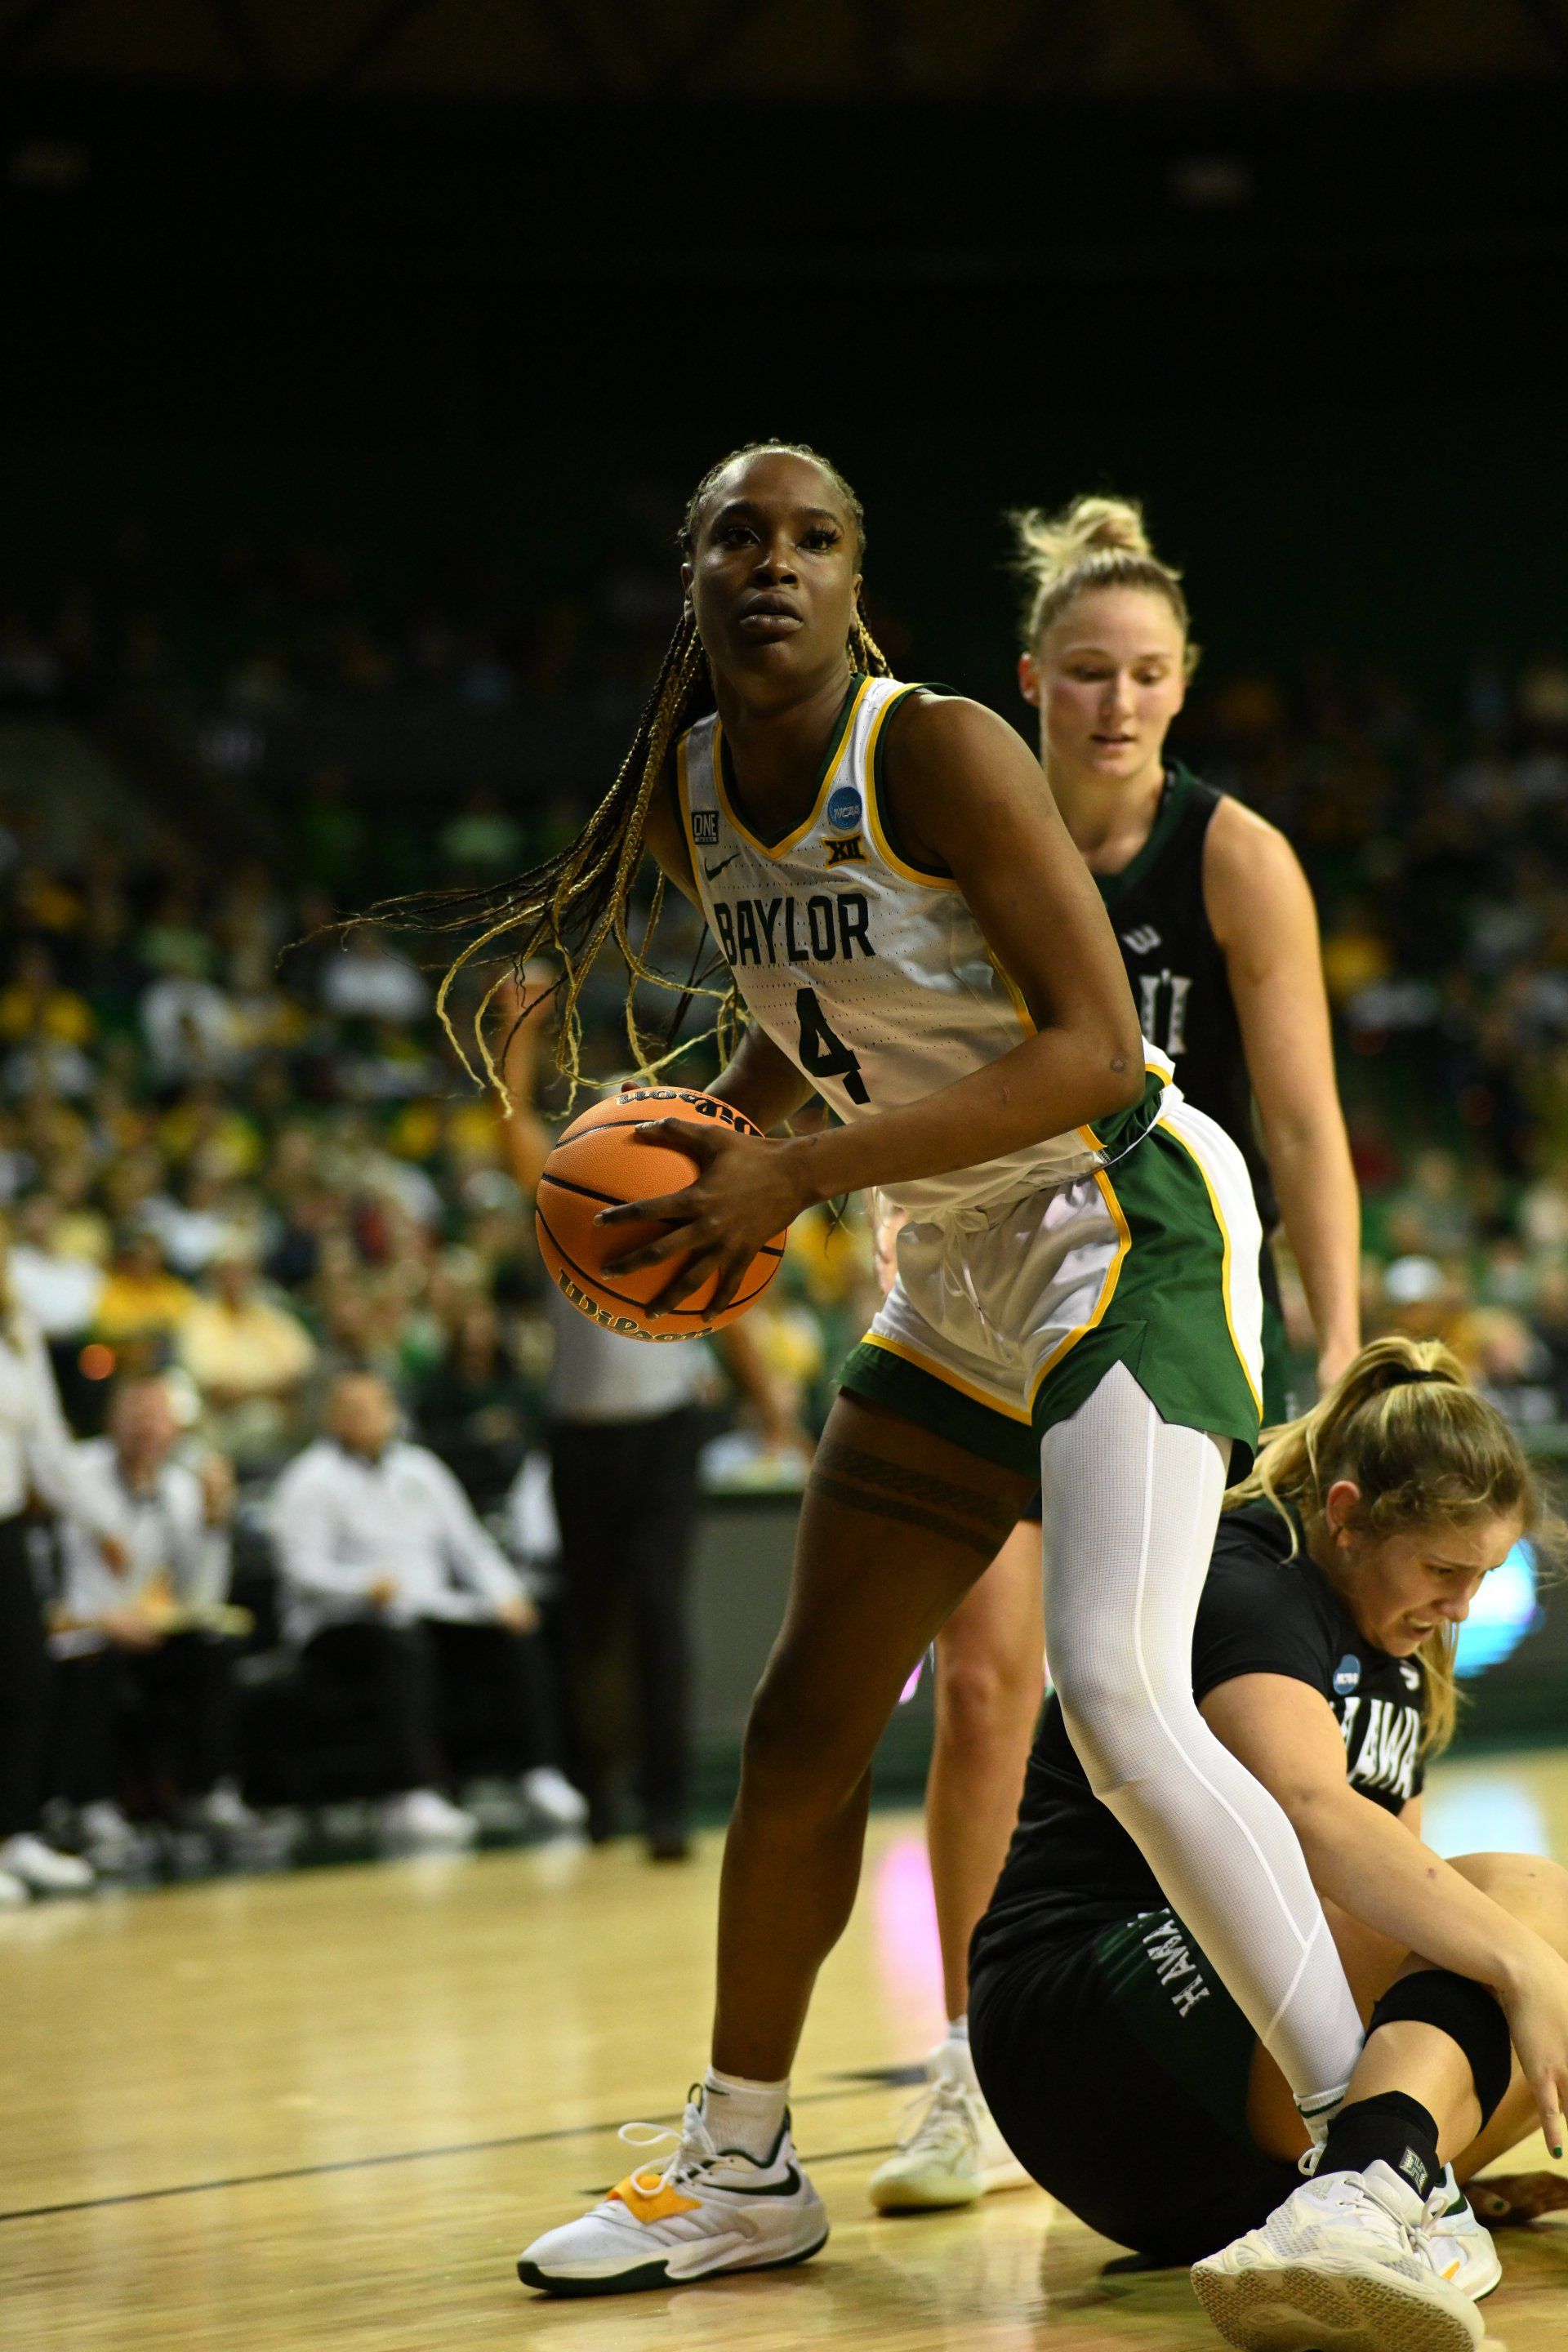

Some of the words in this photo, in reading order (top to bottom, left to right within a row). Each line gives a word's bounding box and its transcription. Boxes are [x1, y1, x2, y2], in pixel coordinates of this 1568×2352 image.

[693, 813, 717, 837] ONE
[822, 832, 868, 867] XII
[713, 893, 875, 966] BAYLOR
[795, 987, 871, 1105] 4
